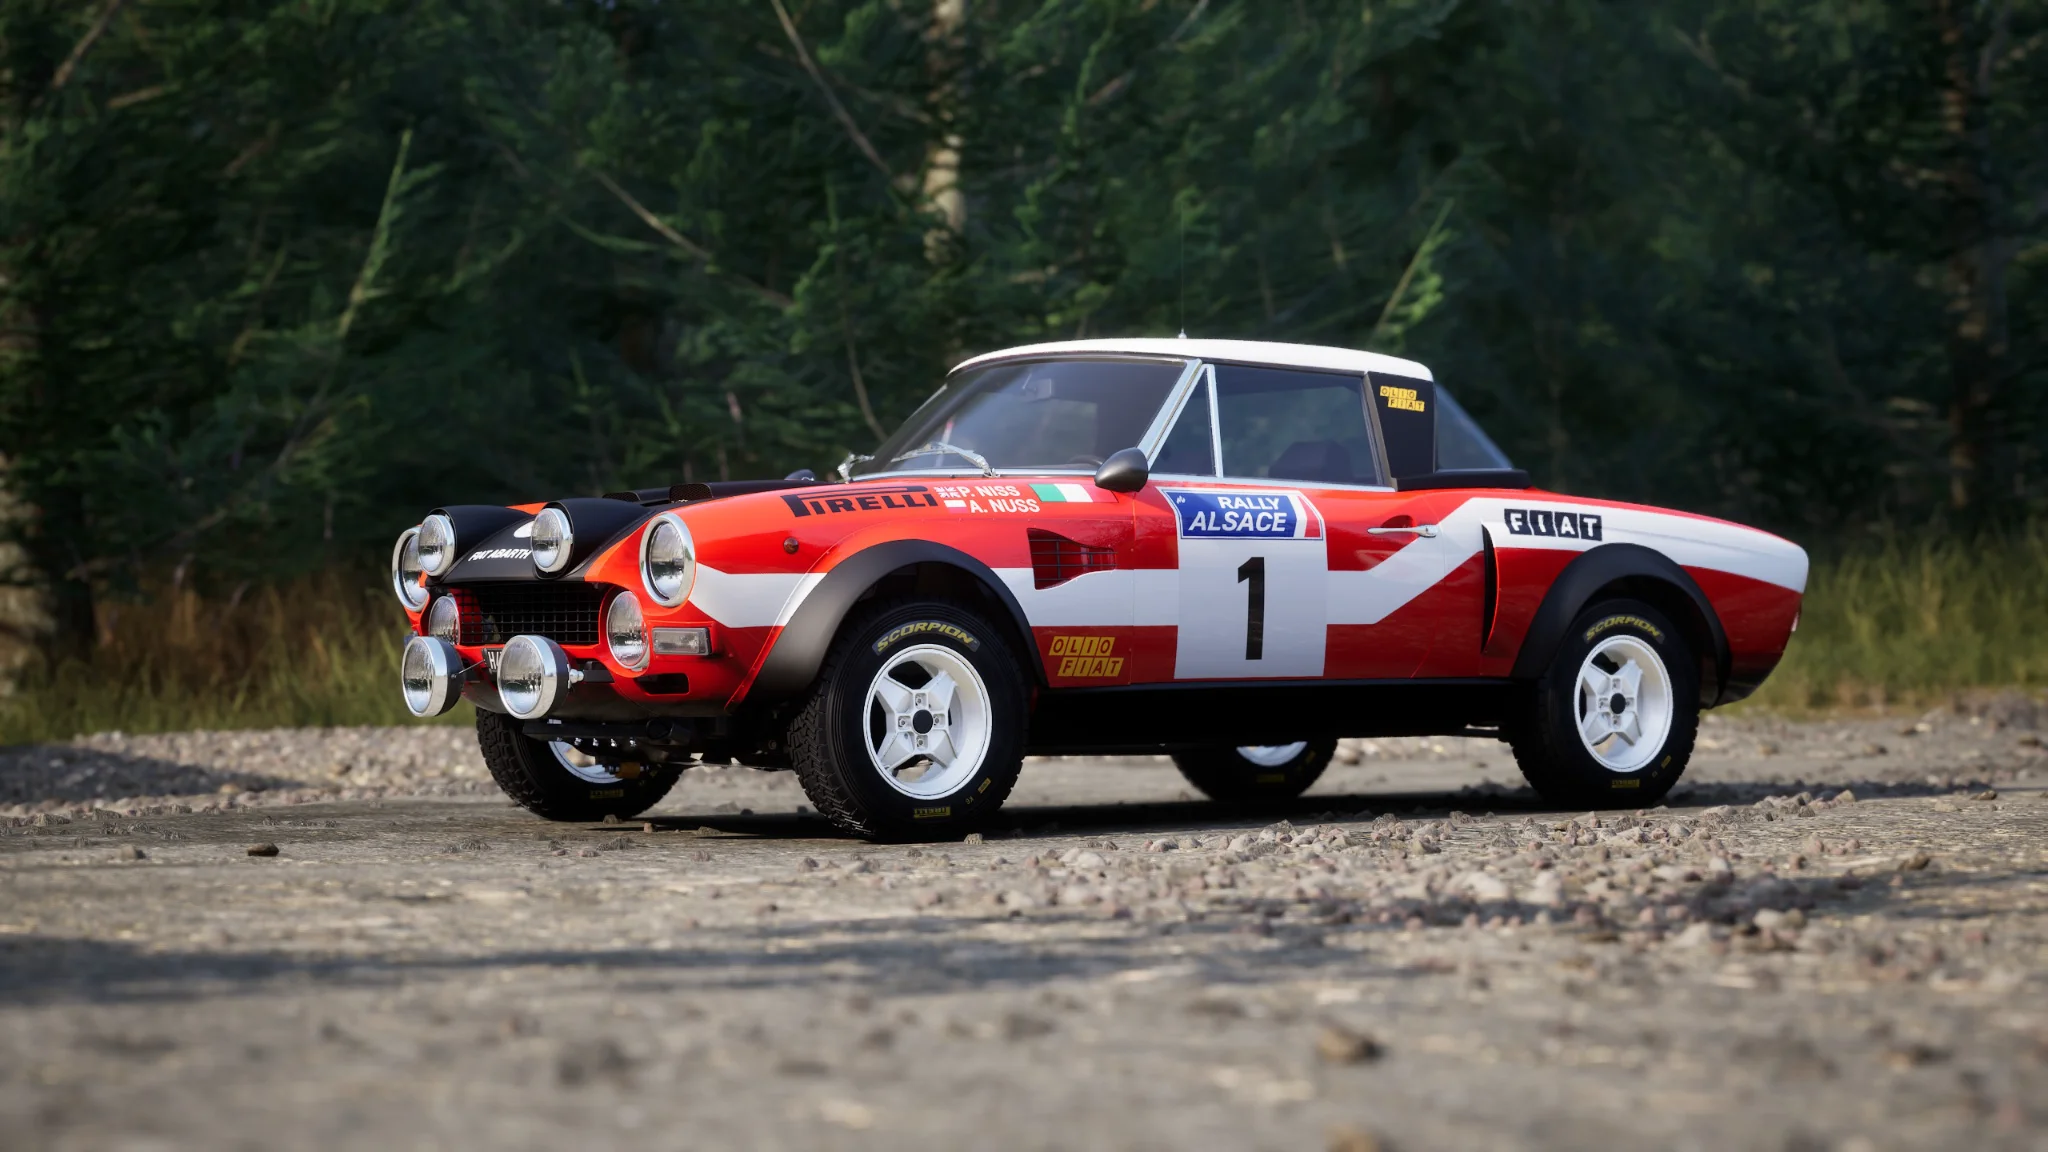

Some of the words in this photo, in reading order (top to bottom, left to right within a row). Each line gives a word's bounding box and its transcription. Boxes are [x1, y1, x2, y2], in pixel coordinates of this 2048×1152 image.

[1381, 387, 1416, 399] OLIO
[1389, 399, 1423, 411] FIAT
[956, 485, 976, 498] P.
[974, 485, 1021, 497] NISS
[780, 485, 938, 517] PIRELLI
[969, 499, 988, 513] A.
[988, 498, 1040, 513] NUSS
[1217, 496, 1280, 510] RALLY
[1188, 510, 1288, 532] ALSACE
[1508, 511, 1599, 538] FIAT
[467, 550, 494, 562] FIAT
[486, 548, 533, 560] ABARTH
[1237, 556, 1265, 660] 1
[1586, 615, 1660, 641] SCORPION
[877, 622, 974, 652] SCORPION
[1052, 637, 1112, 654] OLIO
[1061, 659, 1120, 674] FIAT
